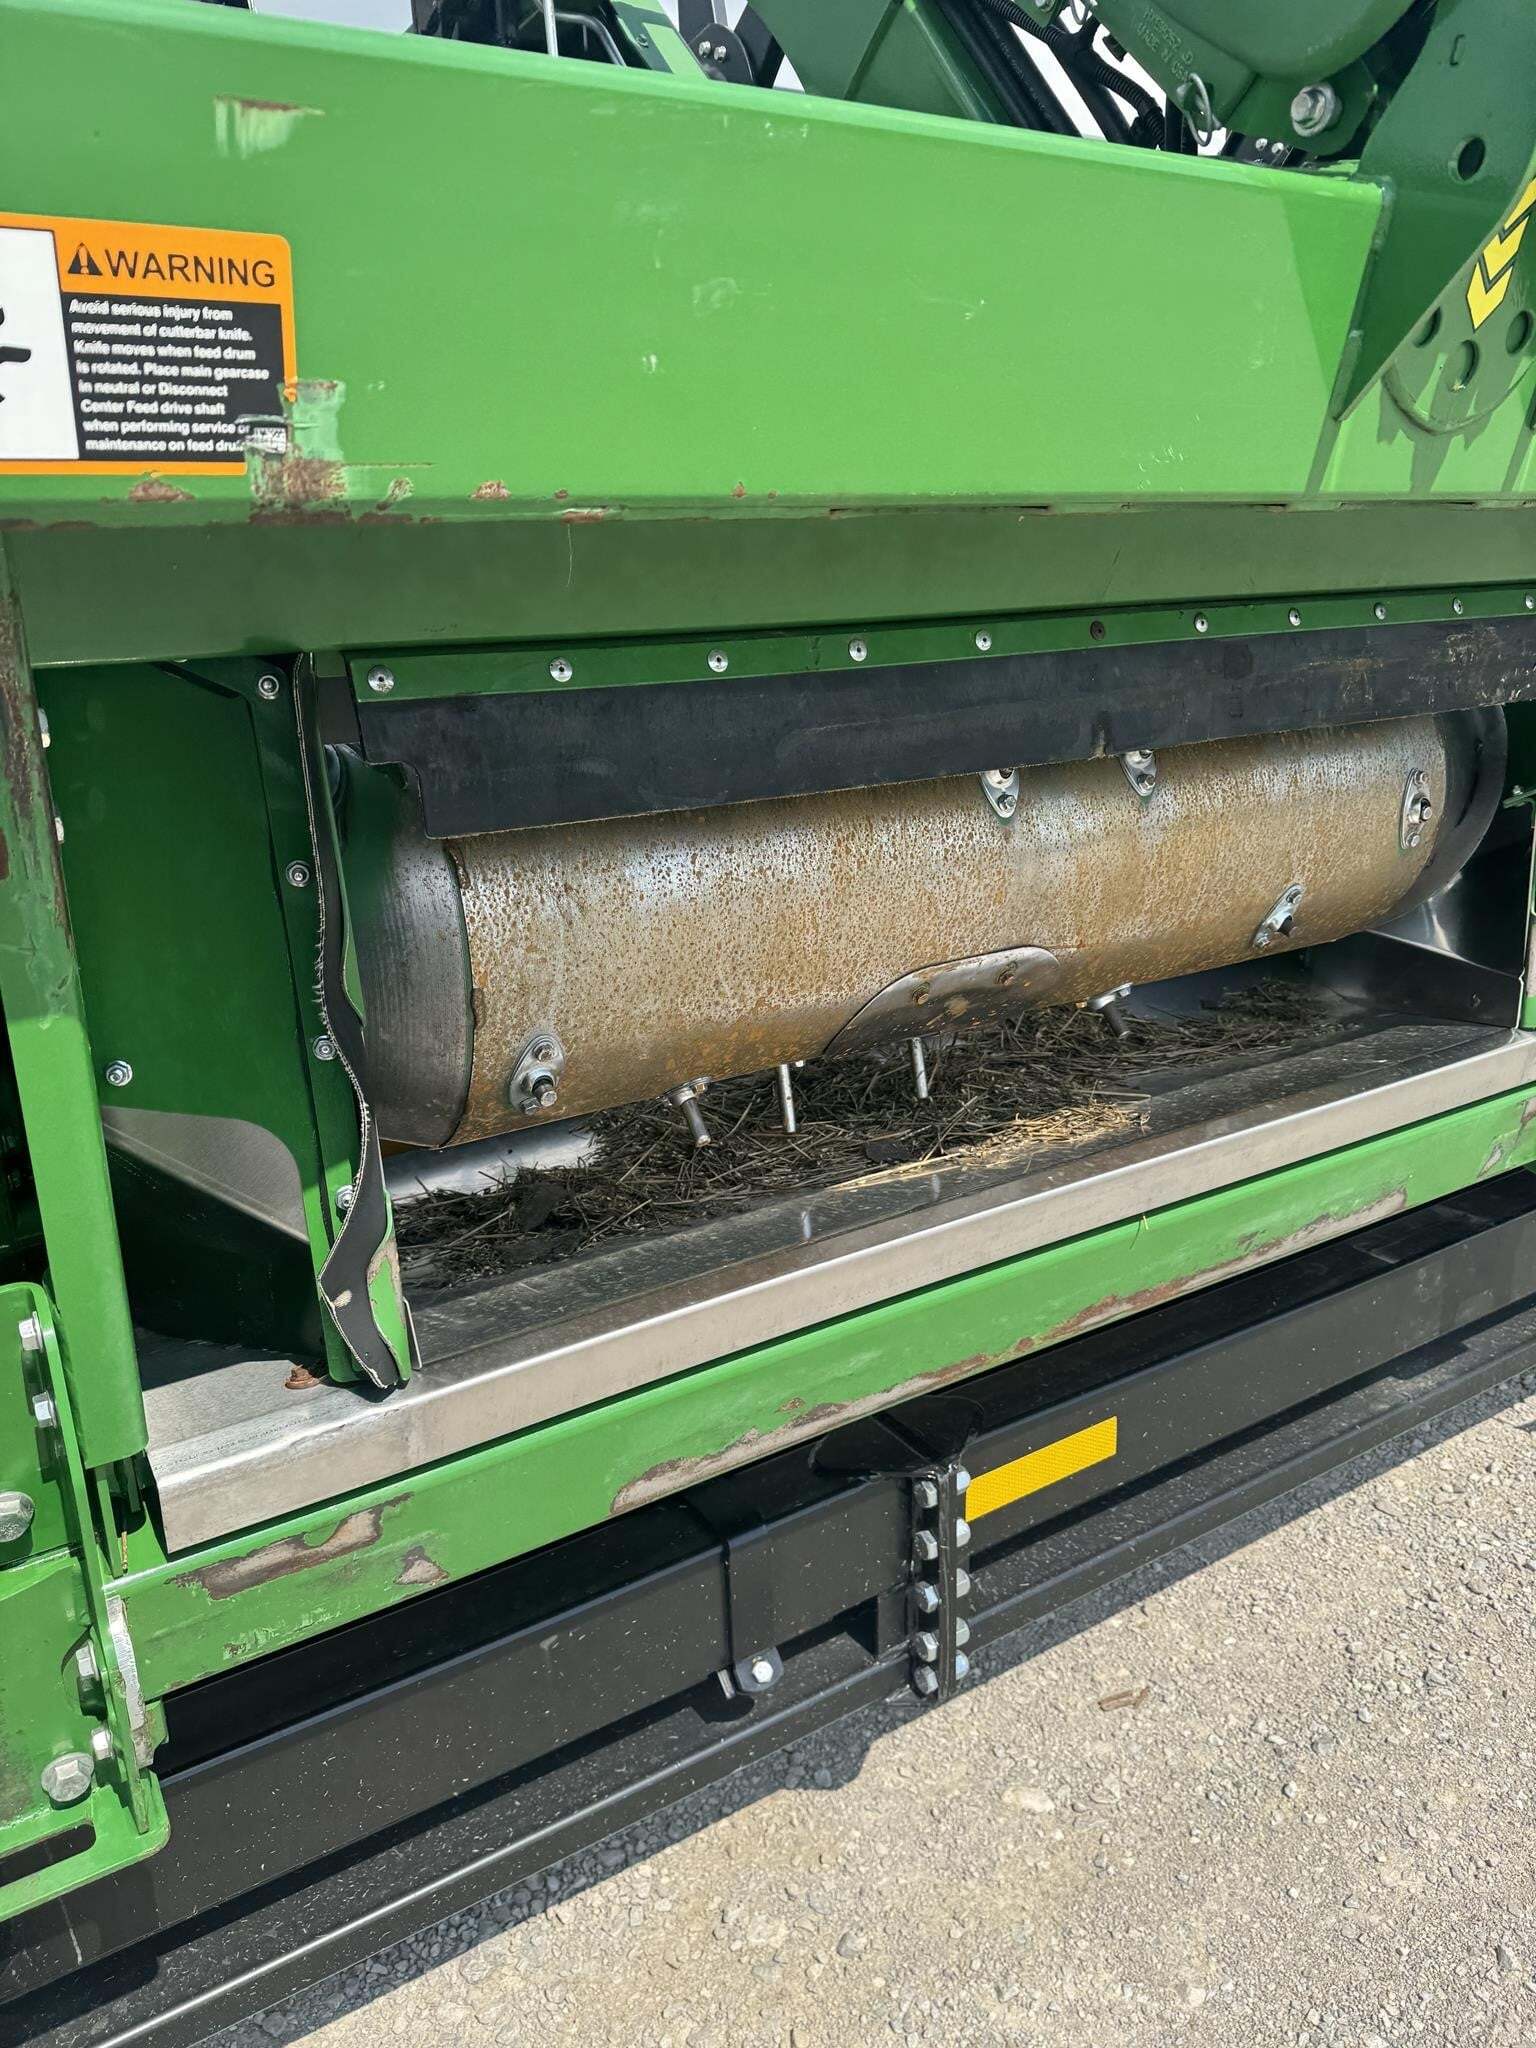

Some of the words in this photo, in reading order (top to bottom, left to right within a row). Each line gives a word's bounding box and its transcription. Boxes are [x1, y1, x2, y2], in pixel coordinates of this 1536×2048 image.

[104, 249, 275, 287] WARNING
[69, 299, 109, 315] Avoid
[111, 303, 161, 318] serious
[163, 304, 201, 322] injury
[202, 306, 233, 320] from
[71, 322, 141, 336] movement
[142, 323, 157, 337] of
[159, 325, 217, 339] cutterbar
[217, 326, 253, 341] knife.
[74, 340, 110, 355] Knife
[111, 344, 155, 357] moves
[156, 344, 192, 358] when
[193, 345, 222, 359] feed
[223, 346, 256, 360] drum
[76, 360, 90, 374] is
[91, 361, 142, 375] rotated.
[143, 362, 179, 377] Place
[181, 364, 213, 377] main
[214, 367, 270, 380] gearcase
[78, 379, 93, 393] in
[94, 381, 140, 394] neutral
[141, 384, 157, 394] or
[158, 382, 228, 397] Disconnect
[80, 399, 125, 413] Center
[126, 400, 159, 414] Feed
[160, 401, 193, 414] drive
[194, 402, 226, 415] shaft
[82, 418, 119, 432] when
[120, 419, 190, 435] performing
[191, 421, 237, 434] service
[85, 438, 167, 451] maintenance
[167, 441, 186, 451] on
[186, 438, 215, 451] feed
[215, 439, 243, 452] dru
